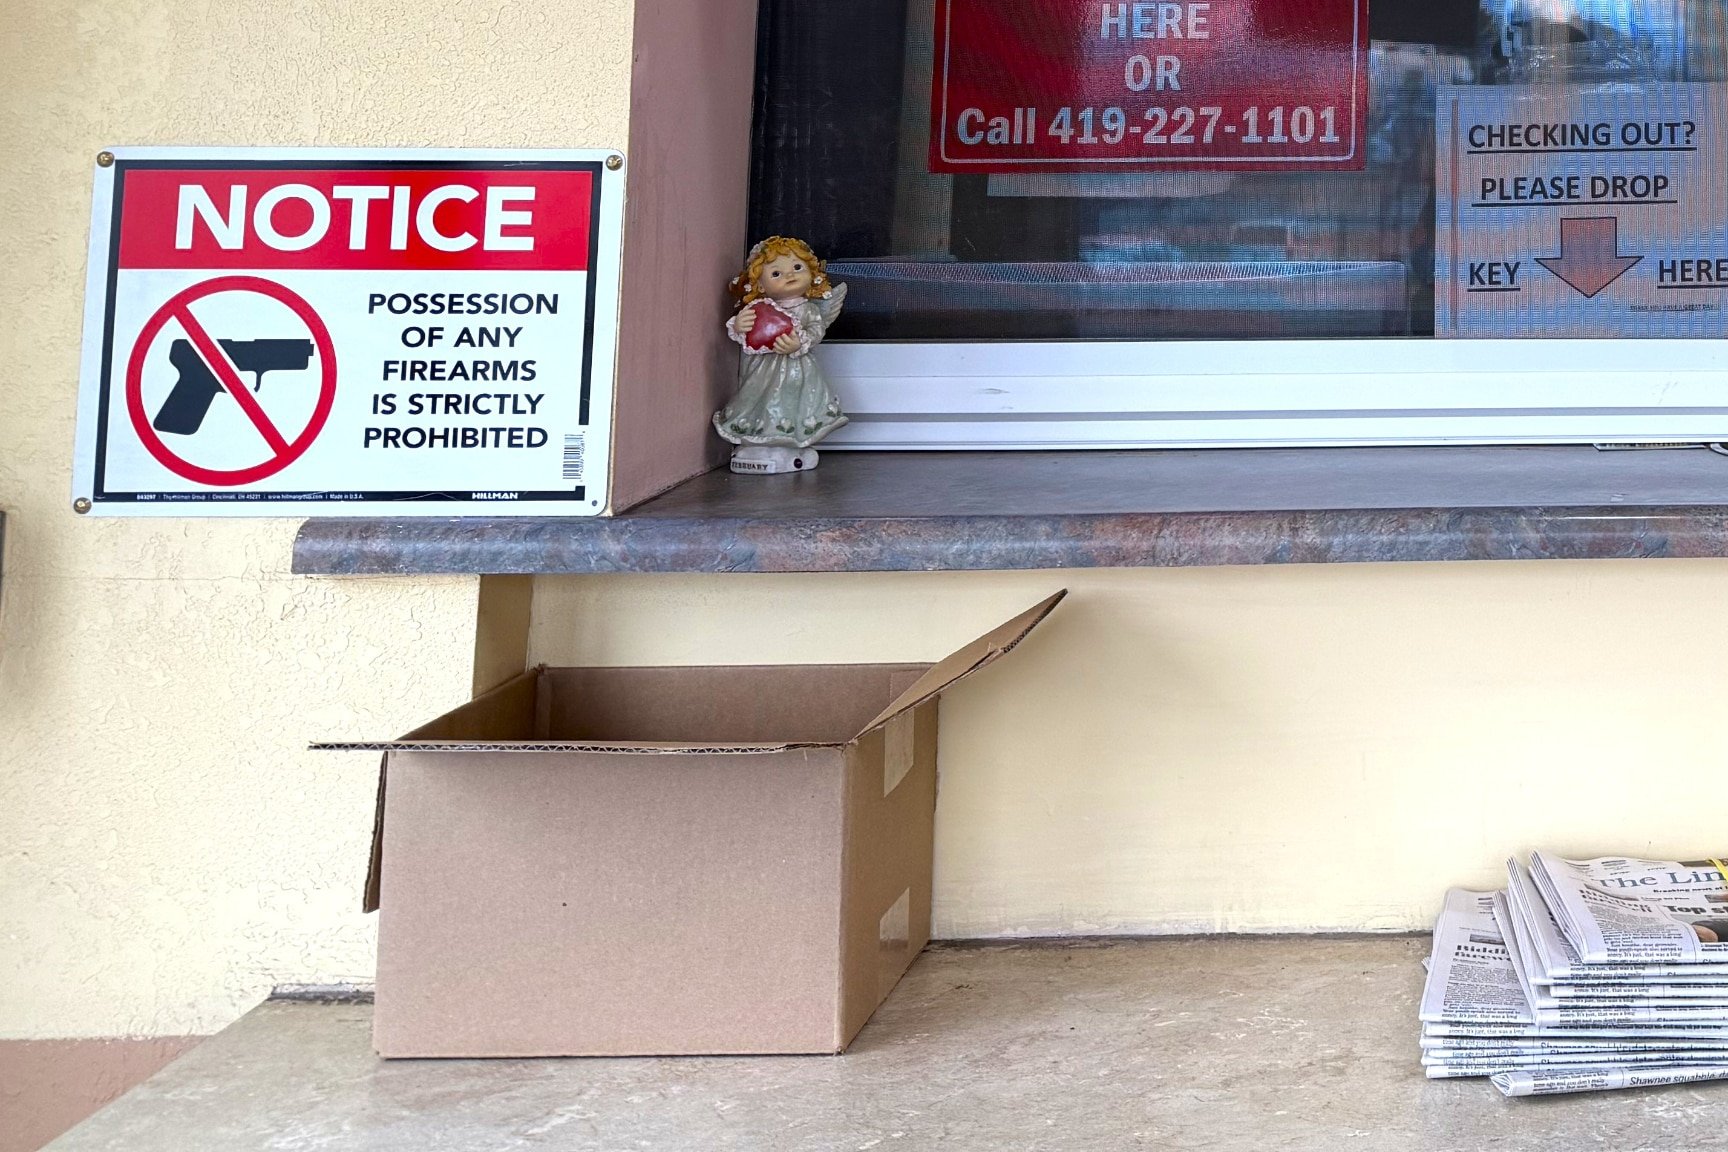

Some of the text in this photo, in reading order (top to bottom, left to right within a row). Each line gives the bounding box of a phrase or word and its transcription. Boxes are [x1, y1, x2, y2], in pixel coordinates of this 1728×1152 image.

[1101, 3, 1210, 39] HERE
[1124, 55, 1182, 91] OR
[957, 105, 1340, 145] Call 419-227-1101
[1468, 121, 1697, 148] CHECKING OUT?
[1481, 174, 1669, 201] PLEASE DROP
[174, 183, 537, 252] NOTICE
[1468, 261, 1521, 287] KEY
[367, 293, 559, 316] POSSESSION
[401, 326, 524, 348] OF ANY
[382, 360, 537, 382] FIREARMS
[373, 394, 545, 415] IS STRICTLY
[363, 427, 549, 449] PROHIBITED
[1594, 874, 1658, 888] The
[1665, 904, 1707, 915] Top
[1629, 1075, 1672, 1086] Shawnee
[1673, 1072, 1716, 1084] squabble,
